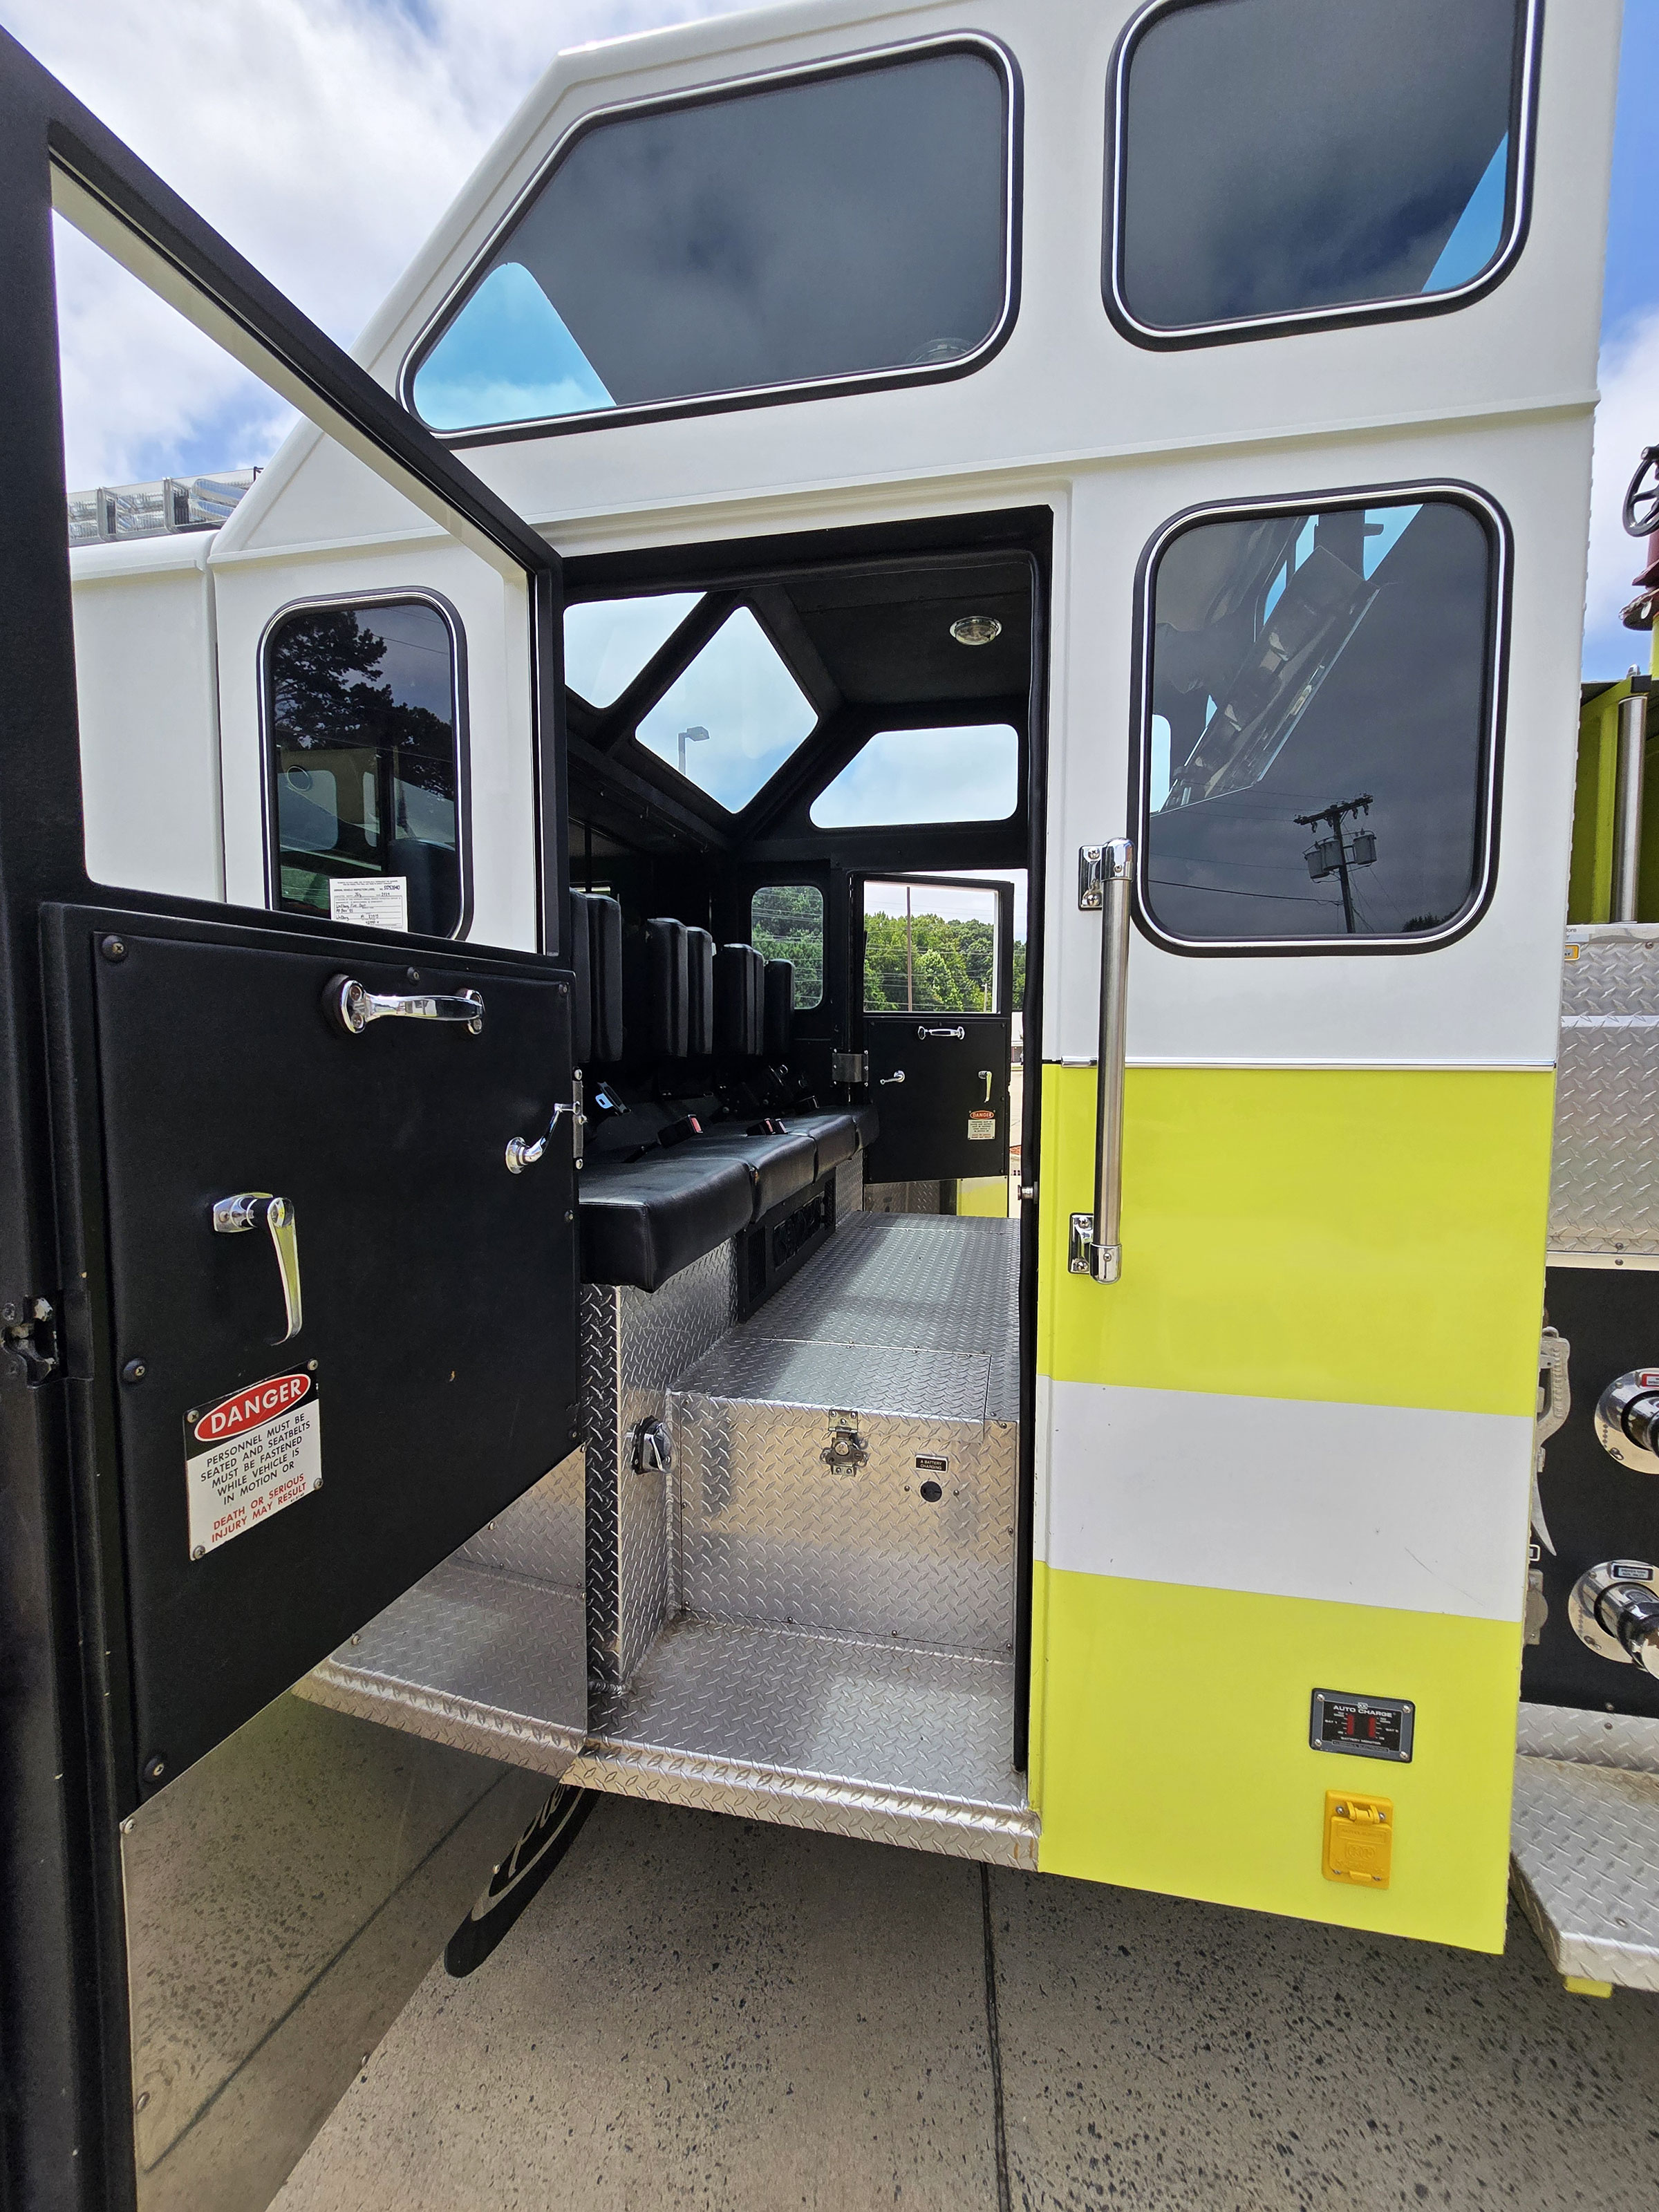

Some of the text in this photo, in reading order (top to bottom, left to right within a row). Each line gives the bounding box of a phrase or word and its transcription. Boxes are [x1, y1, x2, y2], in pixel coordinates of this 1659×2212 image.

[211, 1378, 302, 1434] DANGER
[200, 1421, 310, 1482] SEATED AND SEATBELTS
[207, 1413, 305, 1468] PERSONNEL MUST BE
[212, 1436, 302, 1489] MUST BE FASTENED
[217, 1447, 299, 1497] WHILE VEHICLE IS
[223, 1494, 234, 1505] IN
[240, 1470, 277, 1497] MOTION
[282, 1461, 294, 1473] OR
[212, 1517, 247, 1543] INJURY
[252, 1503, 273, 1520] MAY
[278, 1482, 306, 1506] RESULT
[213, 1474, 304, 1530] DEATH OR SERIOUS
[1333, 1705, 1356, 1713] AUTO
[1358, 1709, 1392, 1718] CHARGE
